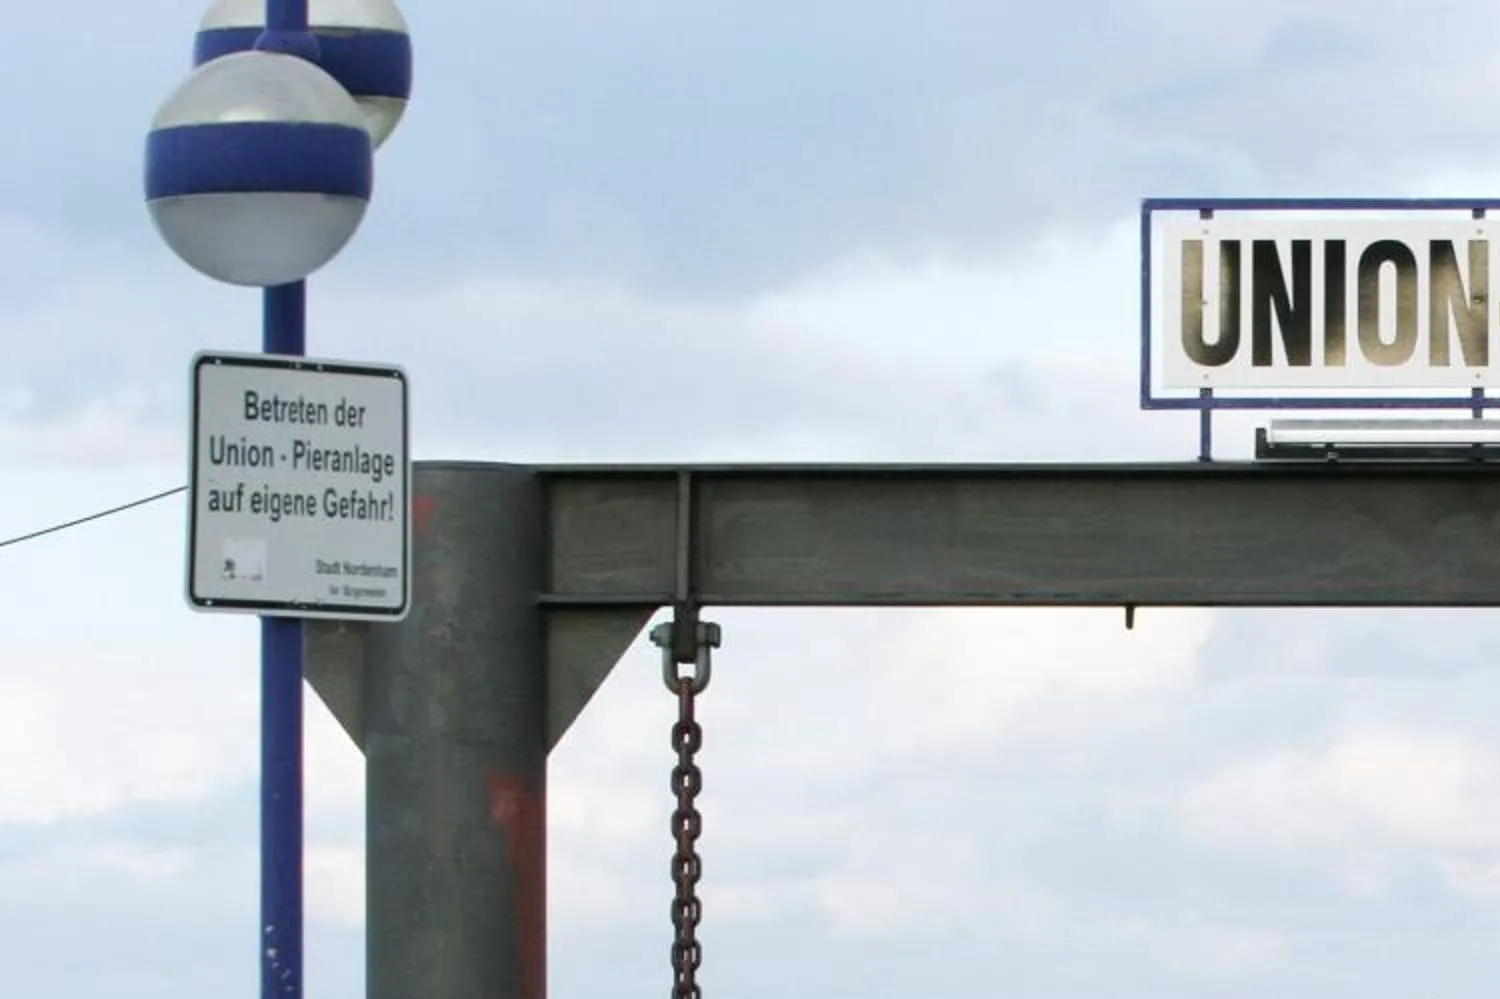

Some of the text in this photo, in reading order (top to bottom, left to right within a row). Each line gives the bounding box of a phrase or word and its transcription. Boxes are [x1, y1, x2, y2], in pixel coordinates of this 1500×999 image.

[244, 390, 366, 428] Betreten der
[209, 435, 274, 468] Union
[293, 440, 395, 482] Pieranlage
[208, 483, 394, 522] auf eigene Gefahr!
